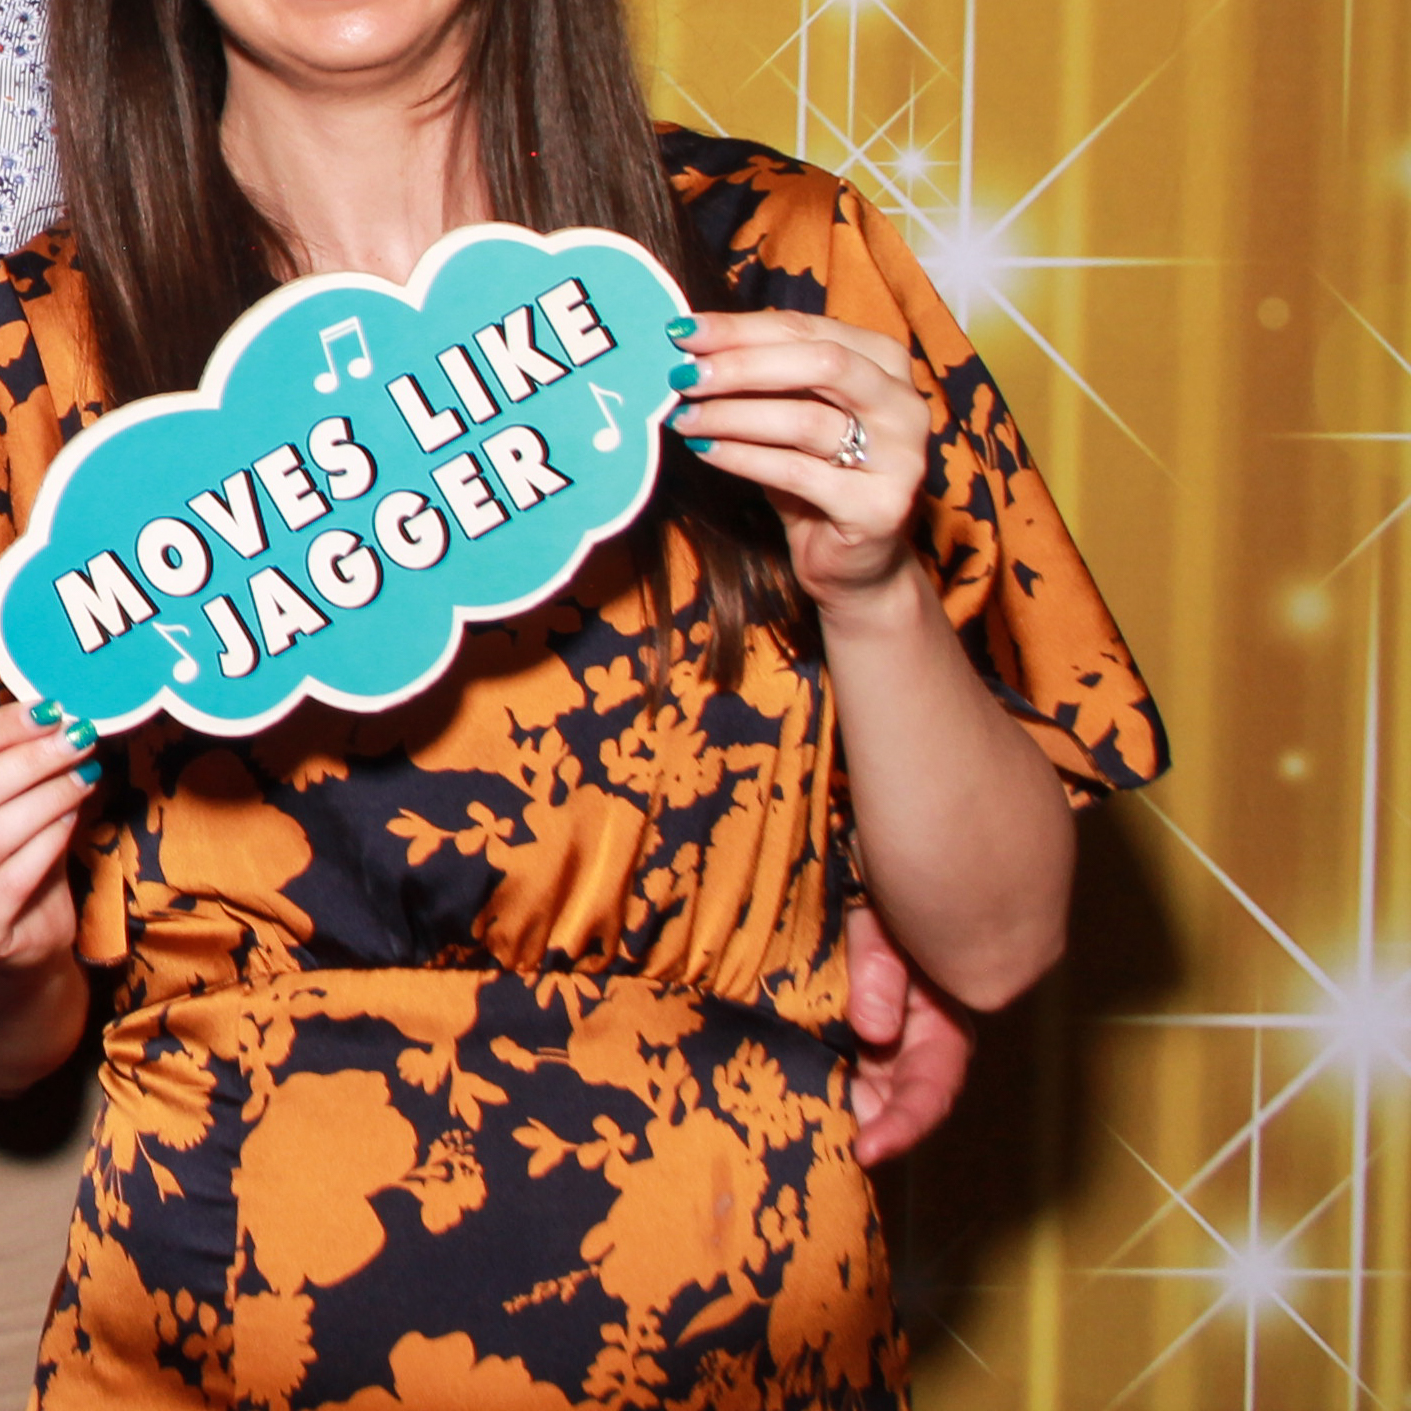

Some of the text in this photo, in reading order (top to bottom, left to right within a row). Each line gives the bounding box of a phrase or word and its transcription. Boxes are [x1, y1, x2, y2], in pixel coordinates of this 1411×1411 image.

[53, 278, 617, 654] MOVES LIKE
[201, 424, 574, 679] JAGGER
